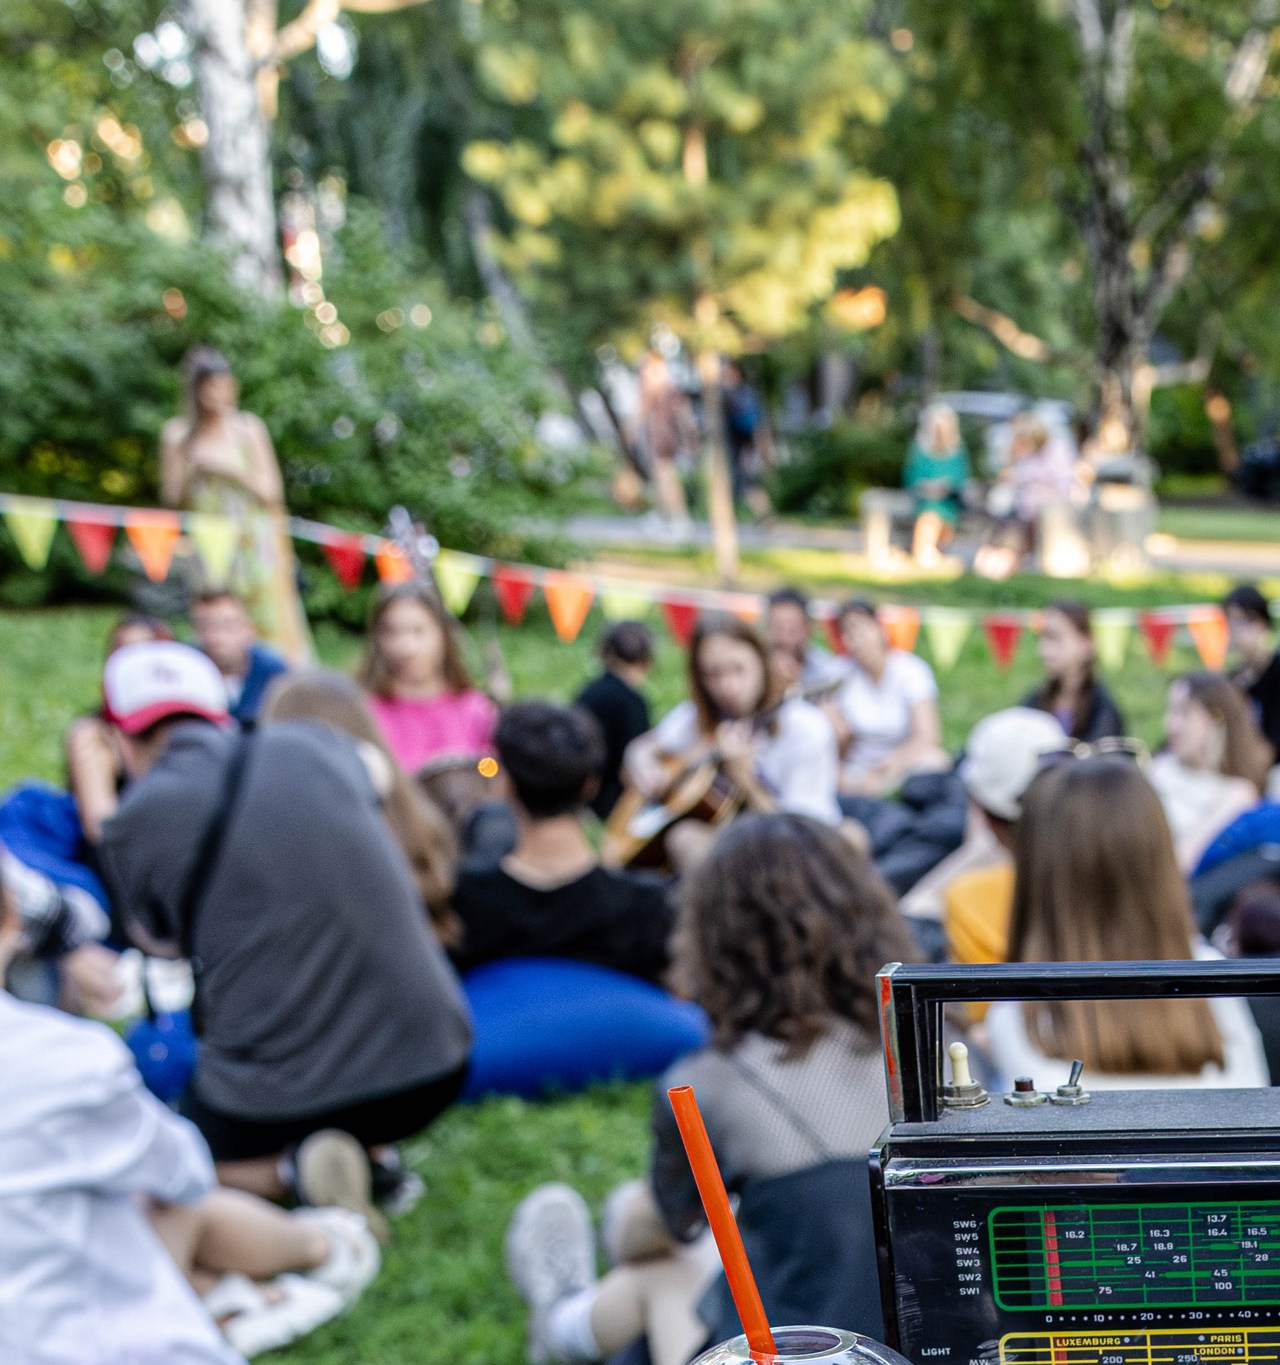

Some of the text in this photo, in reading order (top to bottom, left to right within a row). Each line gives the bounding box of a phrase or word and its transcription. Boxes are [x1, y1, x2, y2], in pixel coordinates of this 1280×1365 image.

[952, 1220, 977, 1229] SW6
[1206, 1214, 1228, 1223] 13.7
[954, 1233, 979, 1242] SW5
[1064, 1231, 1085, 1240] 16.2
[1149, 1229, 1171, 1238] 16.3
[1207, 1228, 1228, 1237] 16.4
[1247, 1227, 1268, 1236] 16.5
[955, 1247, 980, 1256] SW4
[1116, 1243, 1138, 1252] 18.7
[1153, 1242, 1174, 1251] 18.8
[956, 1259, 981, 1268] SW3
[1126, 1256, 1142, 1265] 25
[1172, 1255, 1188, 1264] 26
[1254, 1253, 1269, 1262] 28
[957, 1273, 982, 1282] SW2
[1144, 1270, 1156, 1279] 41
[1213, 1268, 1229, 1278] 45
[959, 1287, 980, 1296] SW1
[1098, 1286, 1113, 1295] 75
[1214, 1281, 1233, 1290] 100
[1093, 1314, 1105, 1323] 10
[1140, 1312, 1155, 1321] 20
[1188, 1311, 1203, 1320] 30
[1237, 1310, 1252, 1319] 40
[1055, 1337, 1122, 1347] LUXEMBURG
[1209, 1334, 1242, 1344] PARIS
[921, 1347, 951, 1356] LIGHT
[1193, 1346, 1236, 1356] LONDON
[1102, 1356, 1123, 1365] 200
[1177, 1354, 1198, 1363] 250
